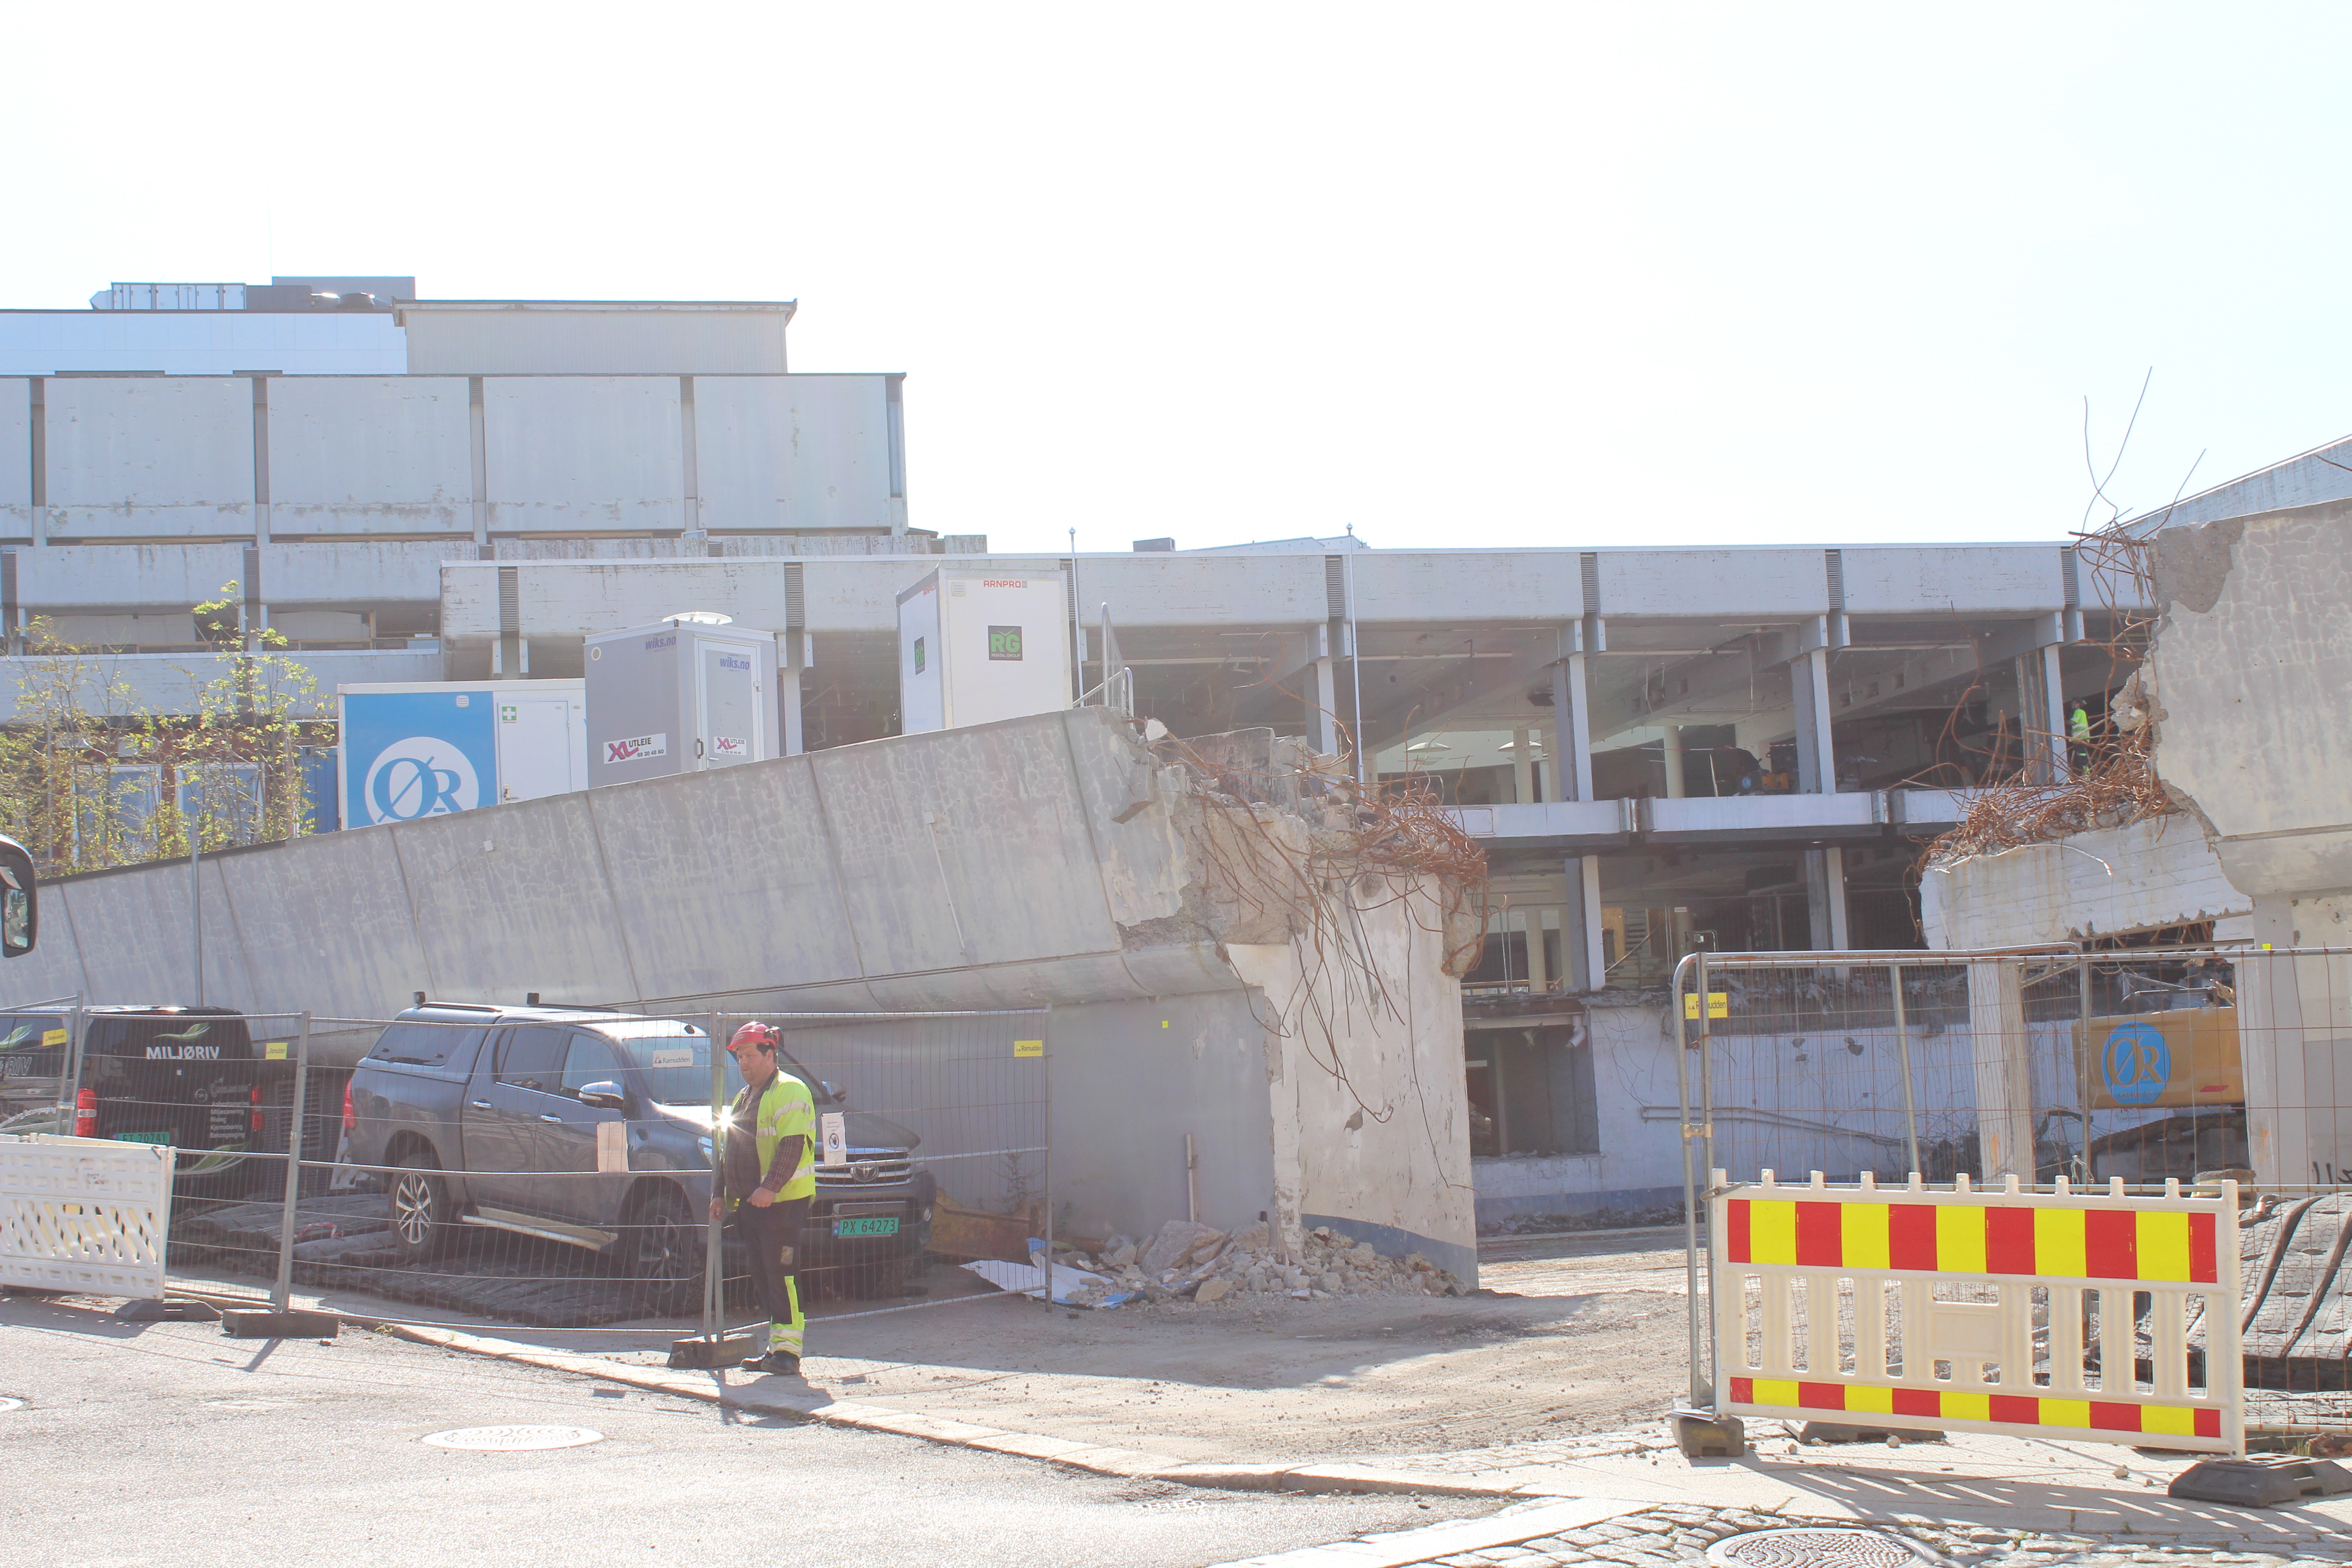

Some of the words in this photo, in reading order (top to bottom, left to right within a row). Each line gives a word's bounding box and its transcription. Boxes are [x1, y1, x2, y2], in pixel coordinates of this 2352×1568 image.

[646, 636, 676, 650] wiks.no
[990, 634, 1020, 653] RG
[915, 646, 924, 667] RG
[720, 657, 750, 670] wiks.no
[608, 741, 639, 762] XL
[629, 737, 652, 747] UTLEIE
[717, 737, 737, 750] XL
[1696, 1000, 1726, 1009] Rudden
[146, 1046, 220, 1059] MILJØRIV
[138, 1133, 166, 1143] 70741
[843, 1220, 856, 1233] PX
[861, 1220, 895, 1233] 64273
